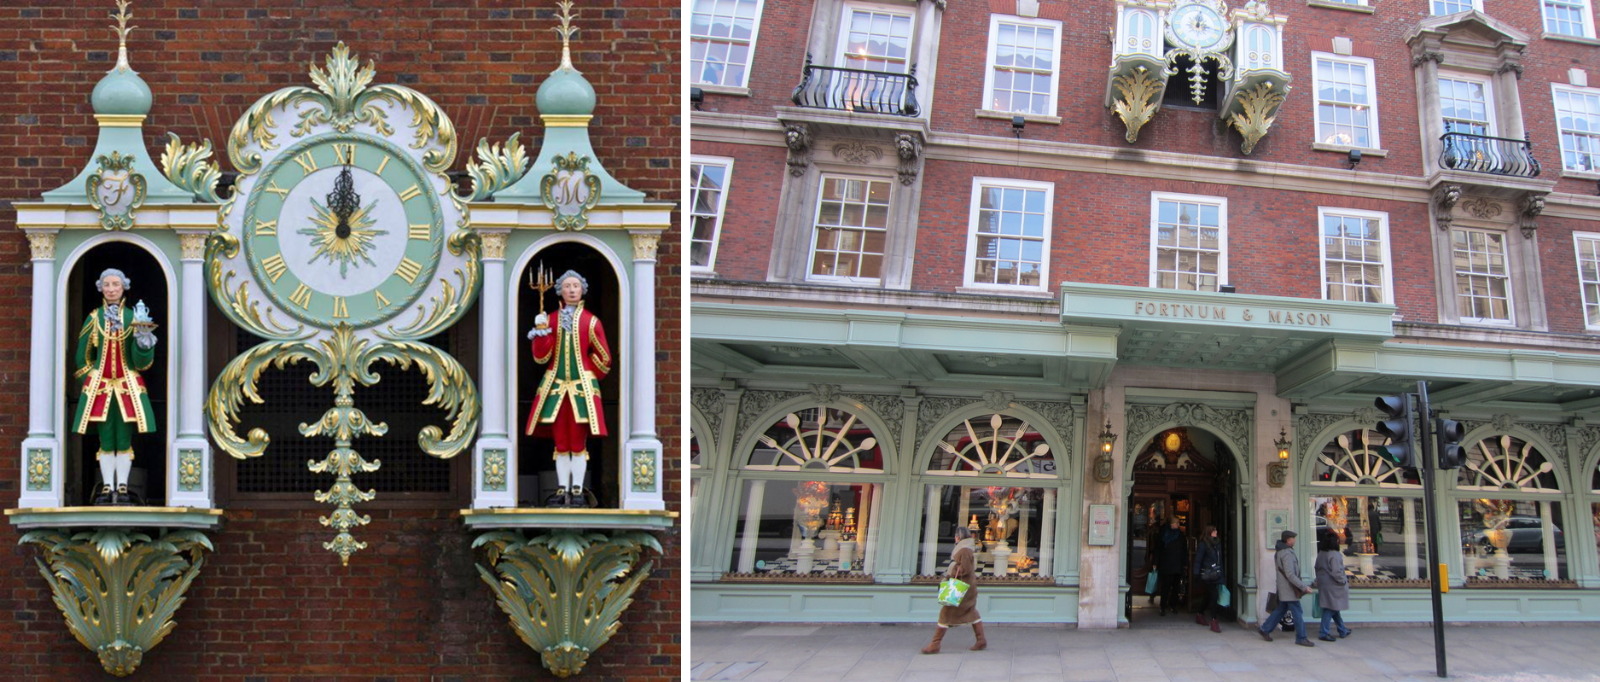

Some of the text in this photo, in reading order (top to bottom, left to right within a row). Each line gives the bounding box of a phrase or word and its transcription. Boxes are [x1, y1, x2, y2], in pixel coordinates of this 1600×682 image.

[295, 151, 318, 175] XI
[332, 144, 356, 165] XII
[377, 155, 390, 175] I
[102, 175, 128, 205] F
[266, 181, 289, 200] X
[400, 184, 422, 202] II
[556, 177, 586, 205] M
[255, 219, 277, 236] IX
[409, 223, 431, 241] III
[262, 254, 286, 283] VIII
[395, 258, 422, 284] IIII
[289, 283, 312, 310] VII
[375, 290, 391, 309] V
[333, 297, 350, 318] VI
[1135, 301, 1331, 326] FORTNUM & MASON
